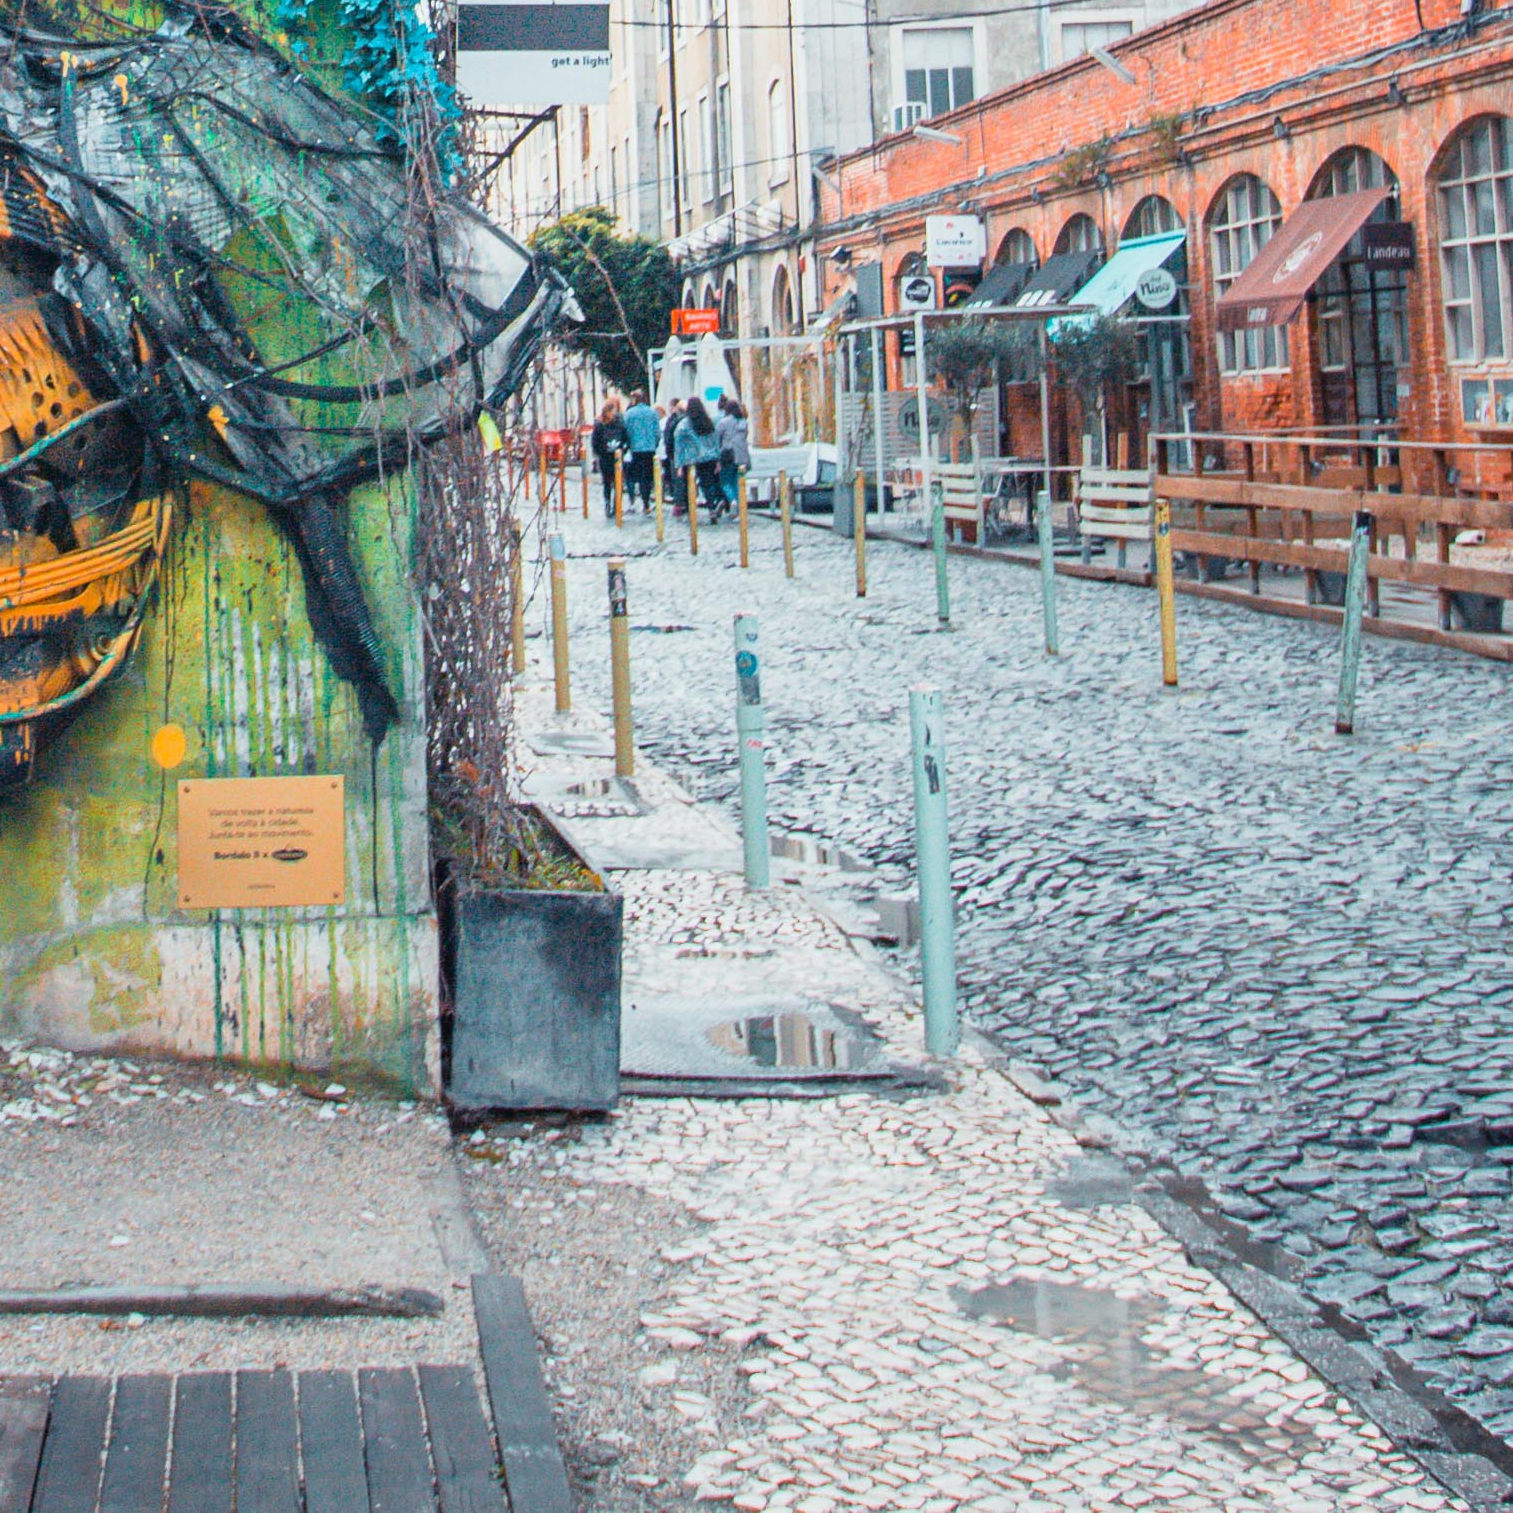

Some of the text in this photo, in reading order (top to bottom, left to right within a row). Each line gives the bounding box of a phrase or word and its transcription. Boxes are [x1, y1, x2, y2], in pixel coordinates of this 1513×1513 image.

[551, 55, 609, 69] get a light
